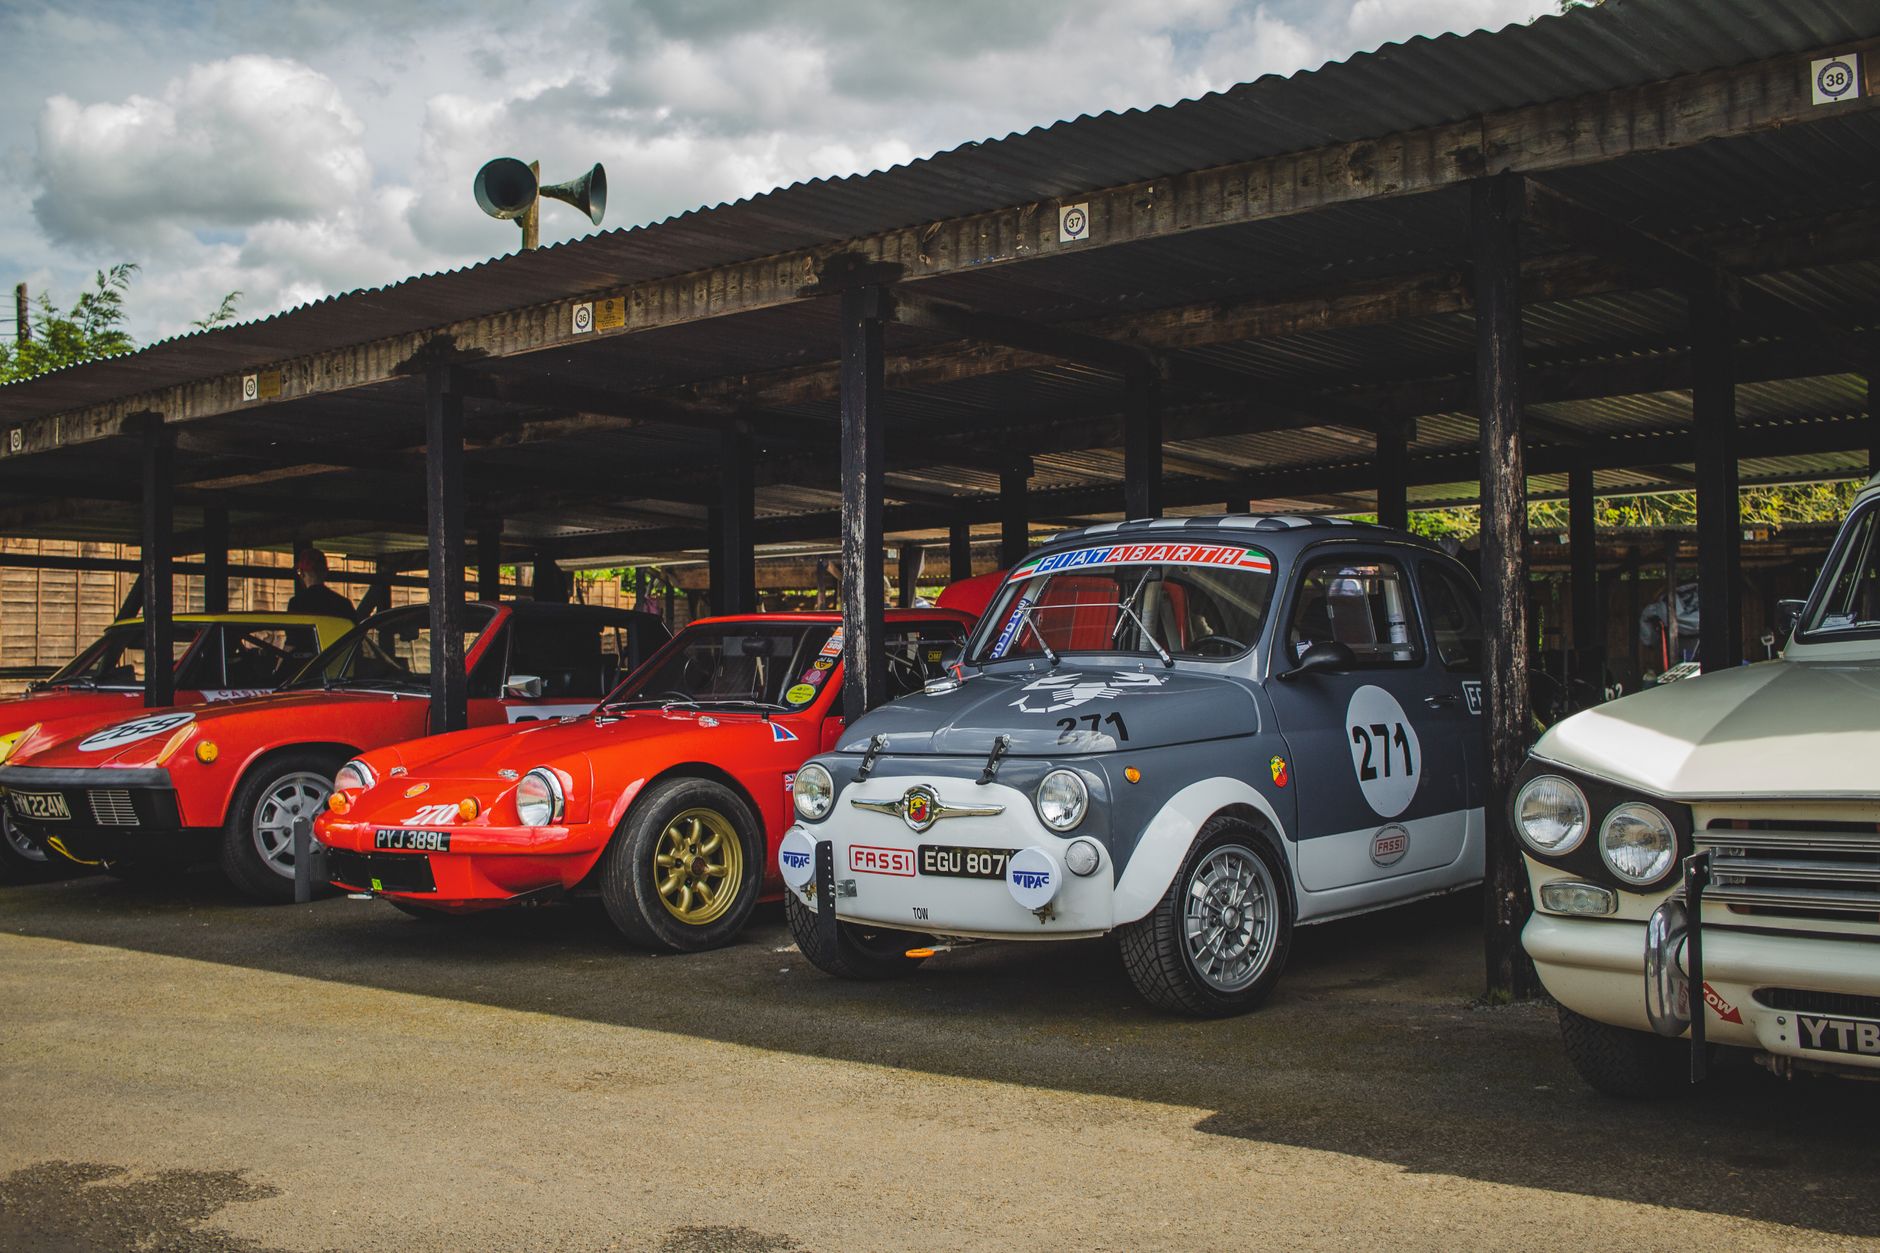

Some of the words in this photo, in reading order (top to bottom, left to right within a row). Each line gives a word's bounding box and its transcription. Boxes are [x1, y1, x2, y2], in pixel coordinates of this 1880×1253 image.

[1825, 72, 1845, 87] 38
[1068, 217, 1081, 229] 37
[578, 313, 587, 324] 36
[1055, 711, 1130, 746] 271
[1352, 722, 1413, 782] 271
[28, 795, 69, 817] 224M
[402, 803, 460, 826] 270
[376, 829, 405, 849] PYJ
[406, 831, 448, 852] 389L
[1377, 838, 1404, 853] FASSI
[783, 852, 810, 868] WIPAC
[854, 850, 910, 872] FASSI
[924, 851, 961, 873] EGU
[1012, 872, 1050, 889] WIPAC
[912, 907, 929, 920] TOW
[1800, 1016, 1880, 1055] YTB
